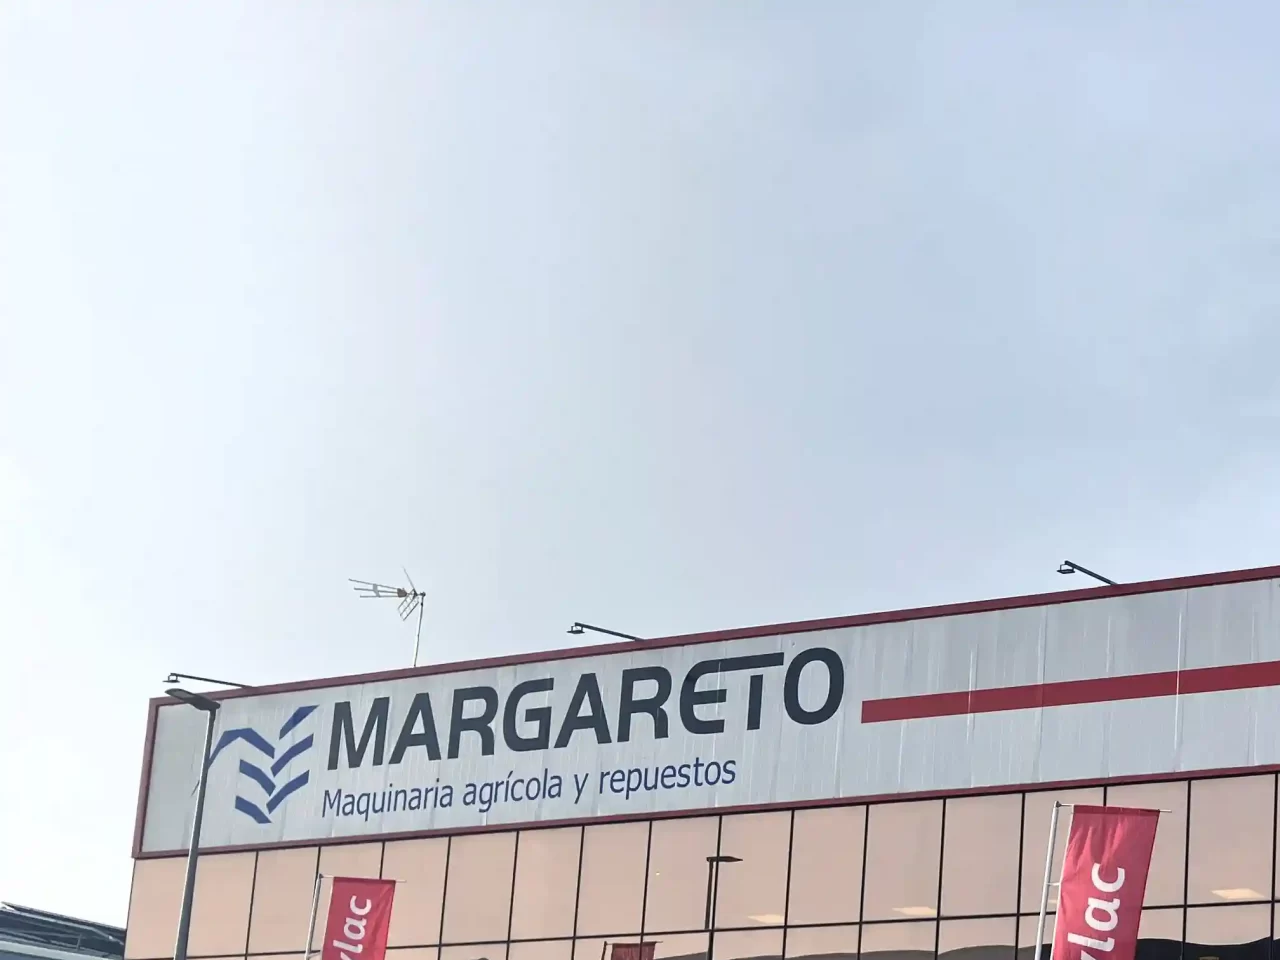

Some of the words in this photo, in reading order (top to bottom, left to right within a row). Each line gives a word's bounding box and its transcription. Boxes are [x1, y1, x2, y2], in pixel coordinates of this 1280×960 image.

[327, 647, 844, 770] MARGARETO
[322, 777, 453, 822] Maquinaria
[463, 768, 562, 814] agrícola
[573, 770, 589, 803] y
[598, 757, 736, 800] repuestos
